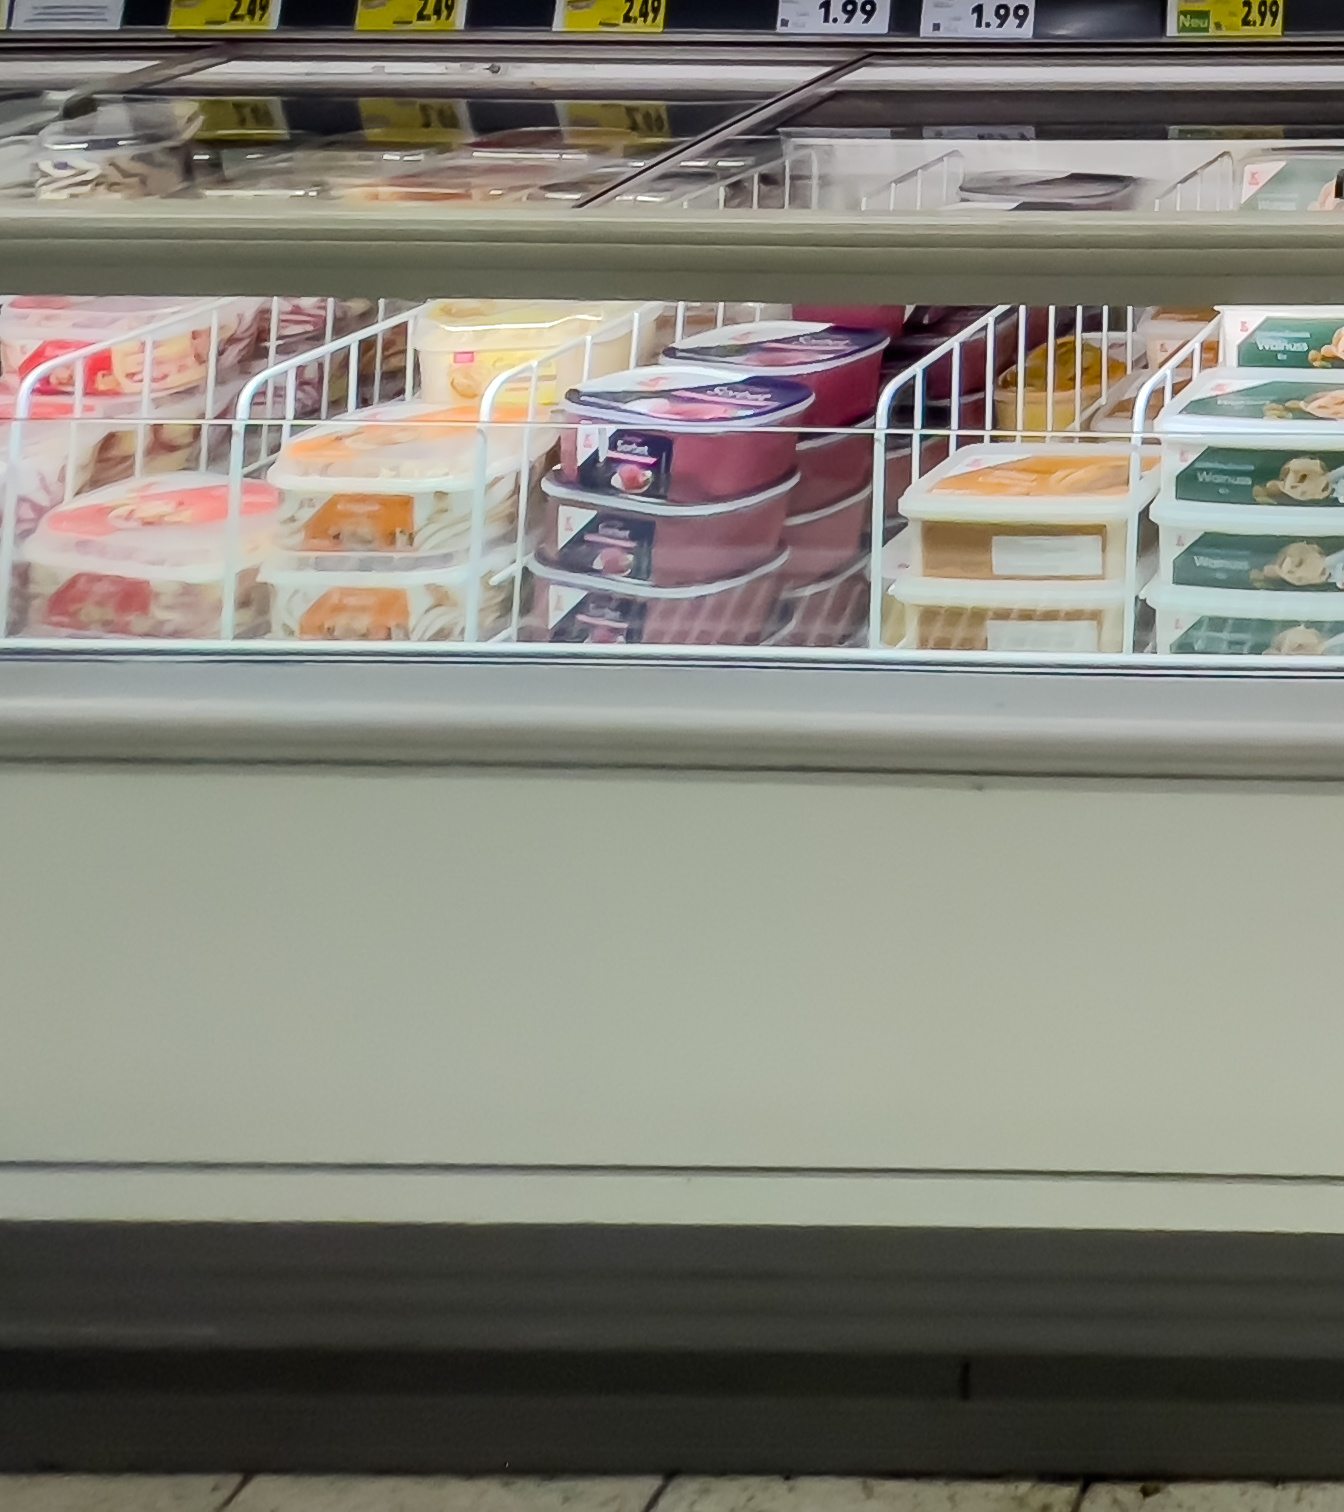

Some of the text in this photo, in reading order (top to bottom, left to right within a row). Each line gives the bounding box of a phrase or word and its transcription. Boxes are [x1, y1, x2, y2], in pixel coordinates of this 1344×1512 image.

[818, 0, 877, 25] 1.99
[969, 2, 1031, 29] 1.99
[1180, 14, 1209, 28] Neu
[1240, 0, 1280, 27] 2.99
[1255, 338, 1310, 352] Walnuss
